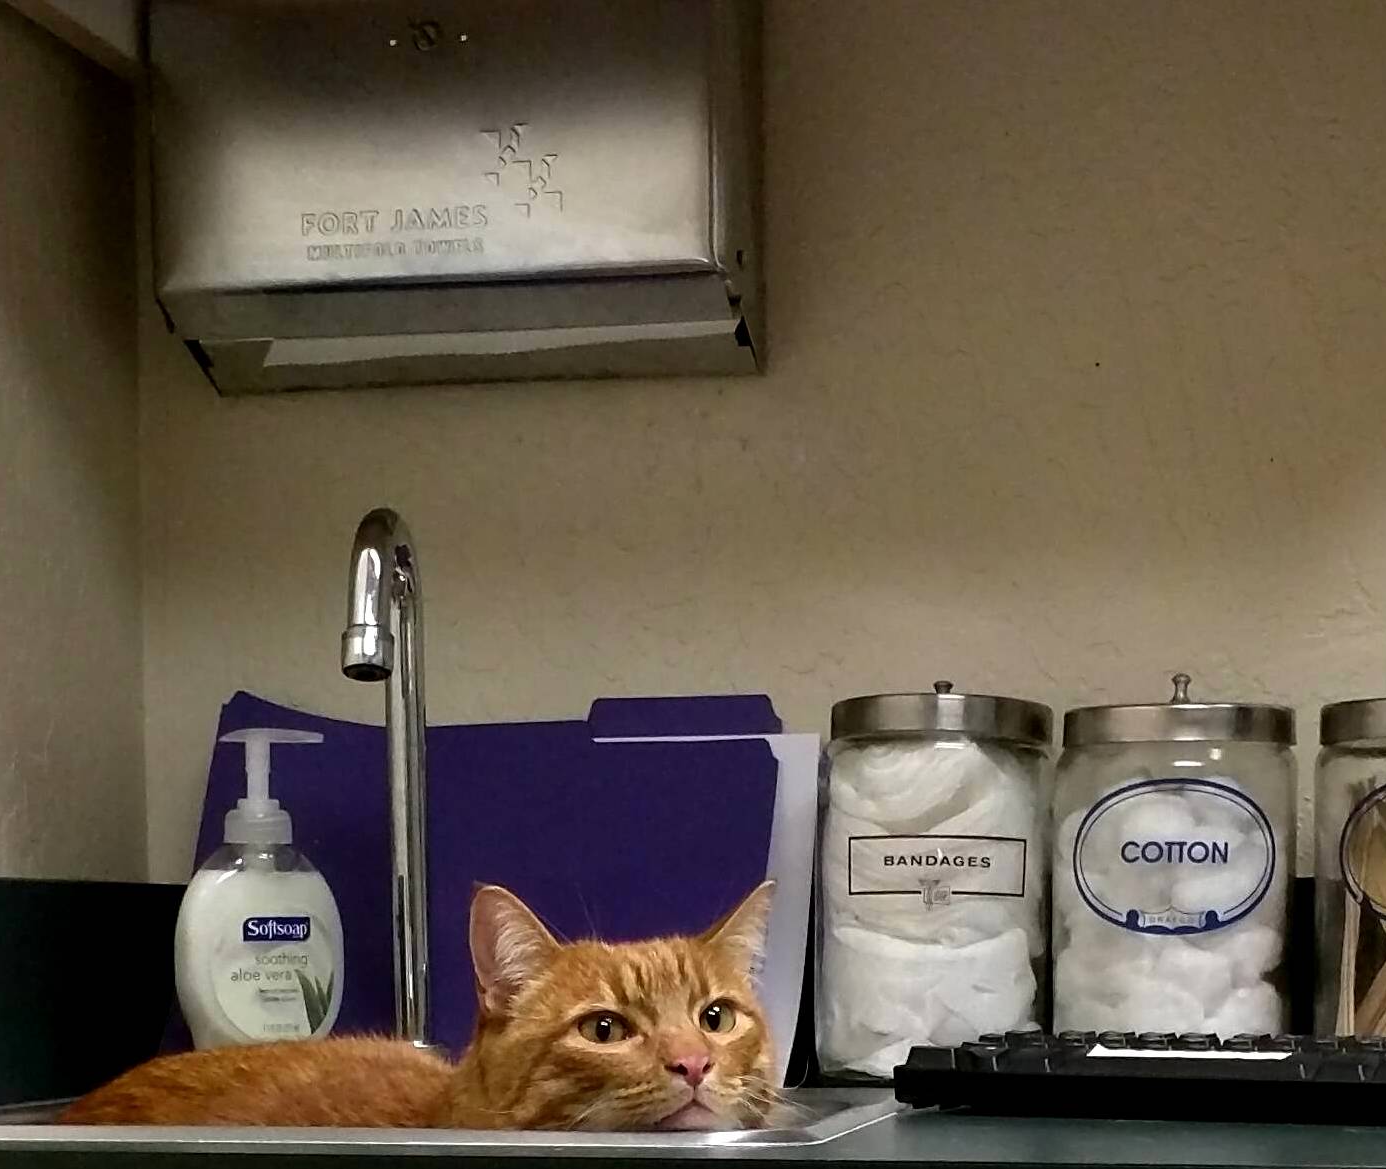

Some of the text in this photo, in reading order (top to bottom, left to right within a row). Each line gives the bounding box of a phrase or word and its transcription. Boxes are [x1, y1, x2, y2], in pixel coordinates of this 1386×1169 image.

[301, 204, 488, 237] FORT JAMES
[1121, 841, 1229, 864] COTTON
[883, 855, 991, 869] BANDAGES
[247, 919, 308, 940] Softsoap
[255, 953, 308, 969] soothing
[230, 968, 261, 982] aloe
